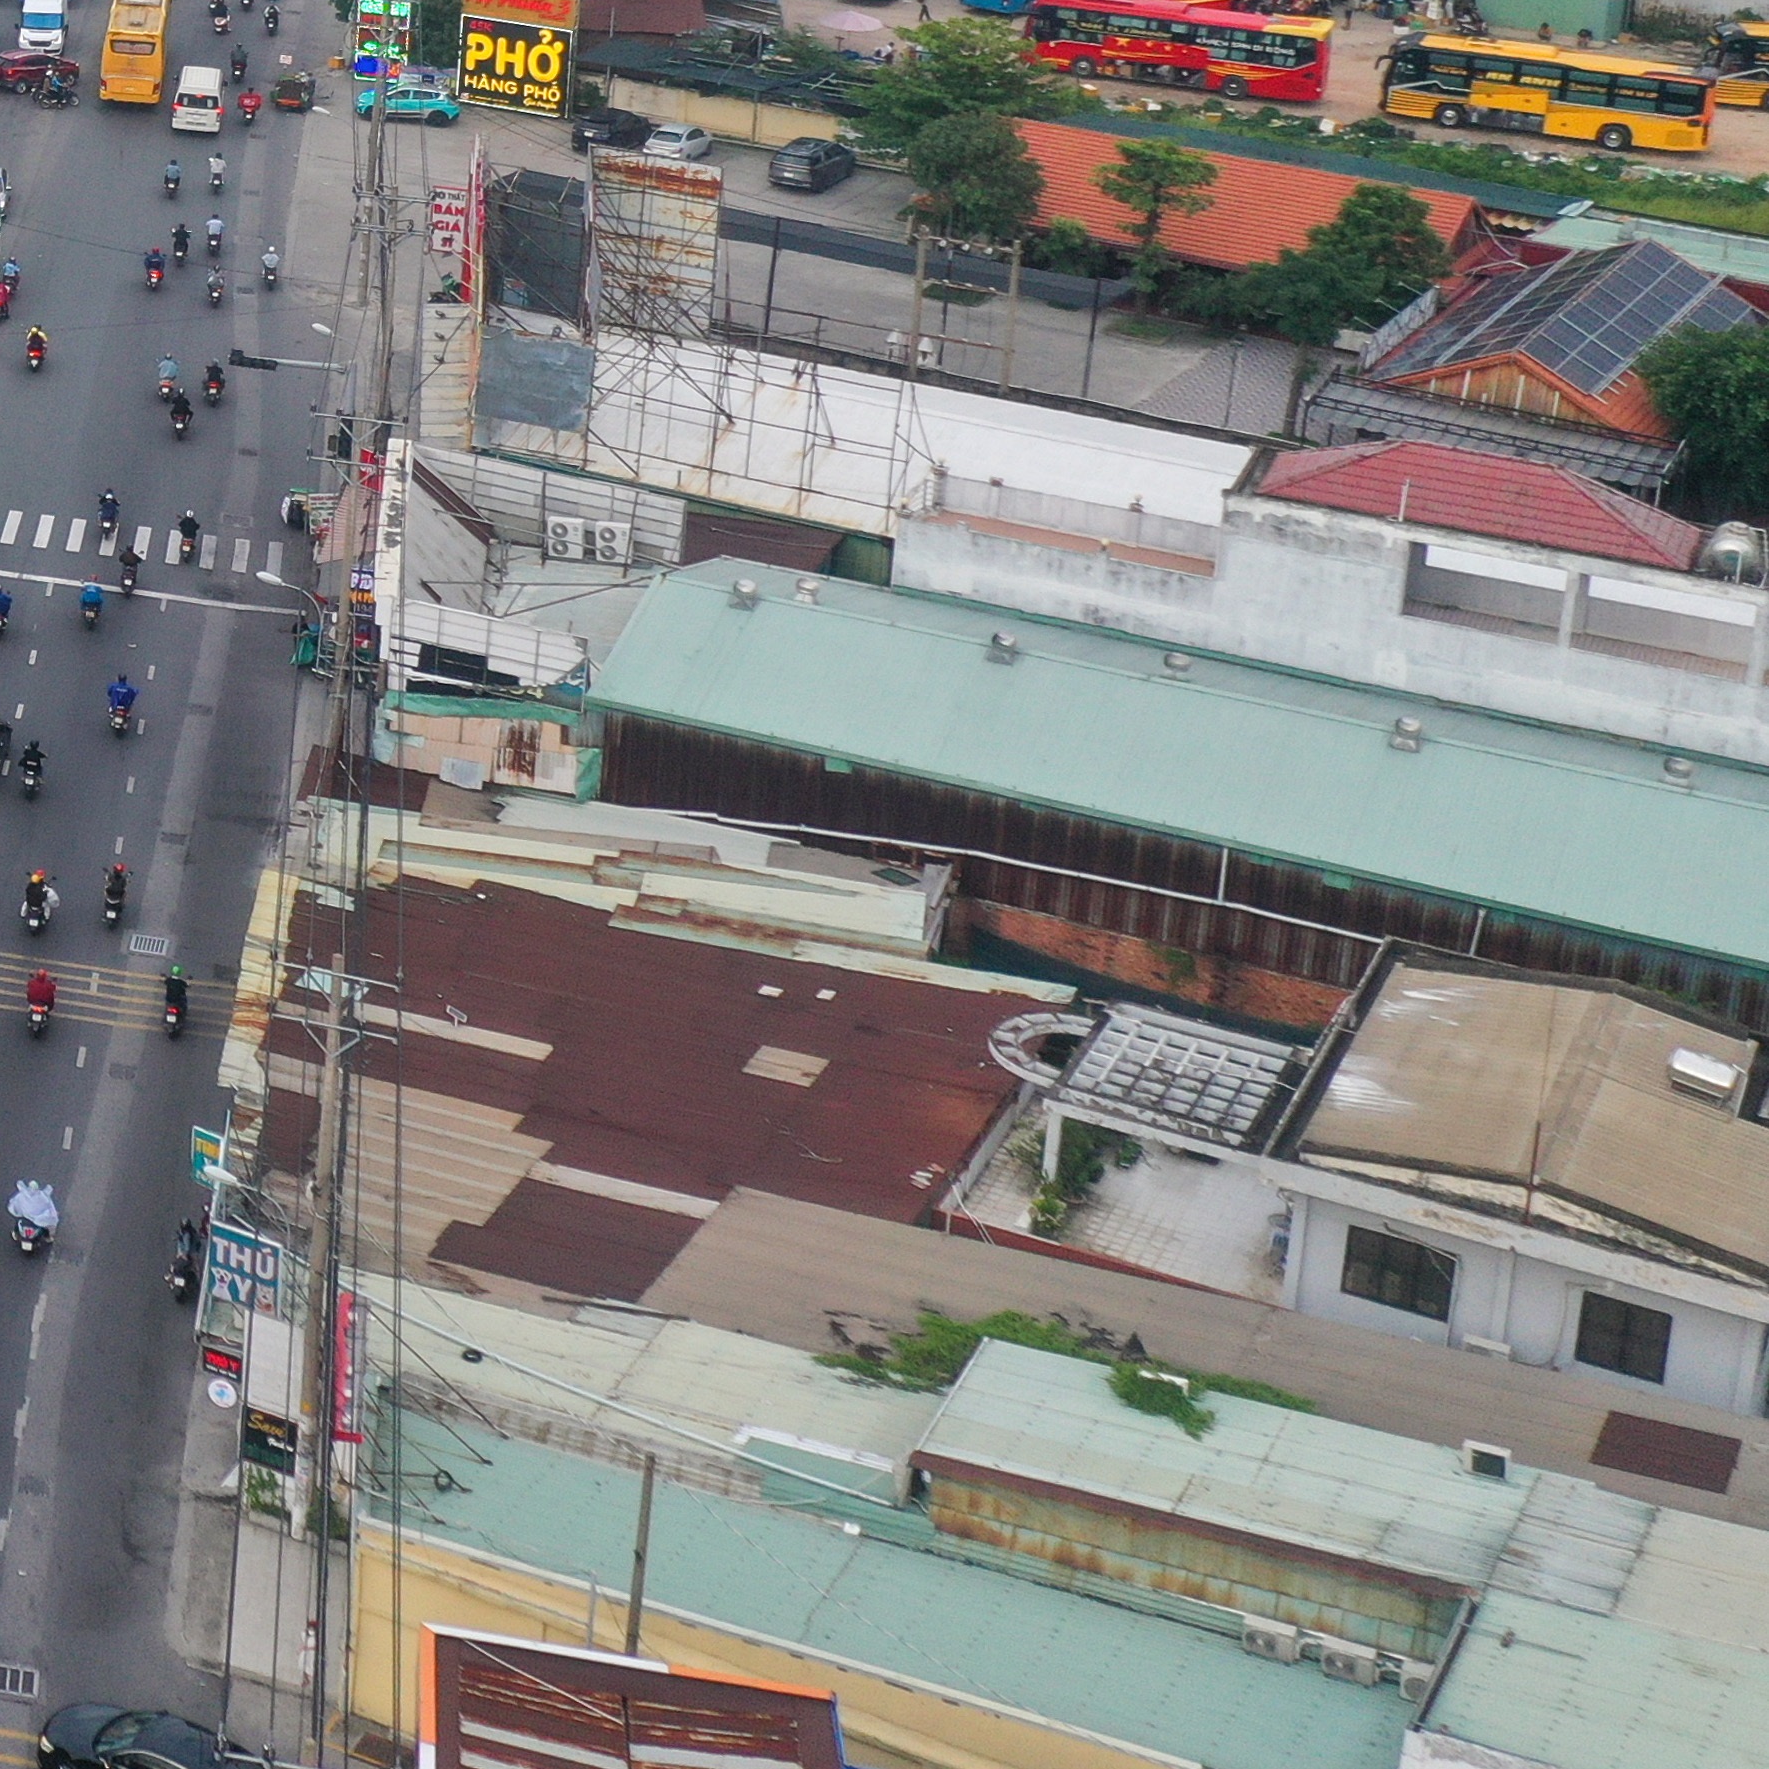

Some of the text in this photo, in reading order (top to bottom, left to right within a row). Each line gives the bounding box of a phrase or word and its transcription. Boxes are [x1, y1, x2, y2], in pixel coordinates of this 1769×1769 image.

[465, 29, 564, 83] PHỞ
[464, 74, 561, 102] HÀNG PHỐ
[434, 202, 464, 216] BÁN
[434, 218, 461, 232] GIÁ
[213, 1235, 274, 1280] THÚ
[233, 1274, 250, 1304] Y
